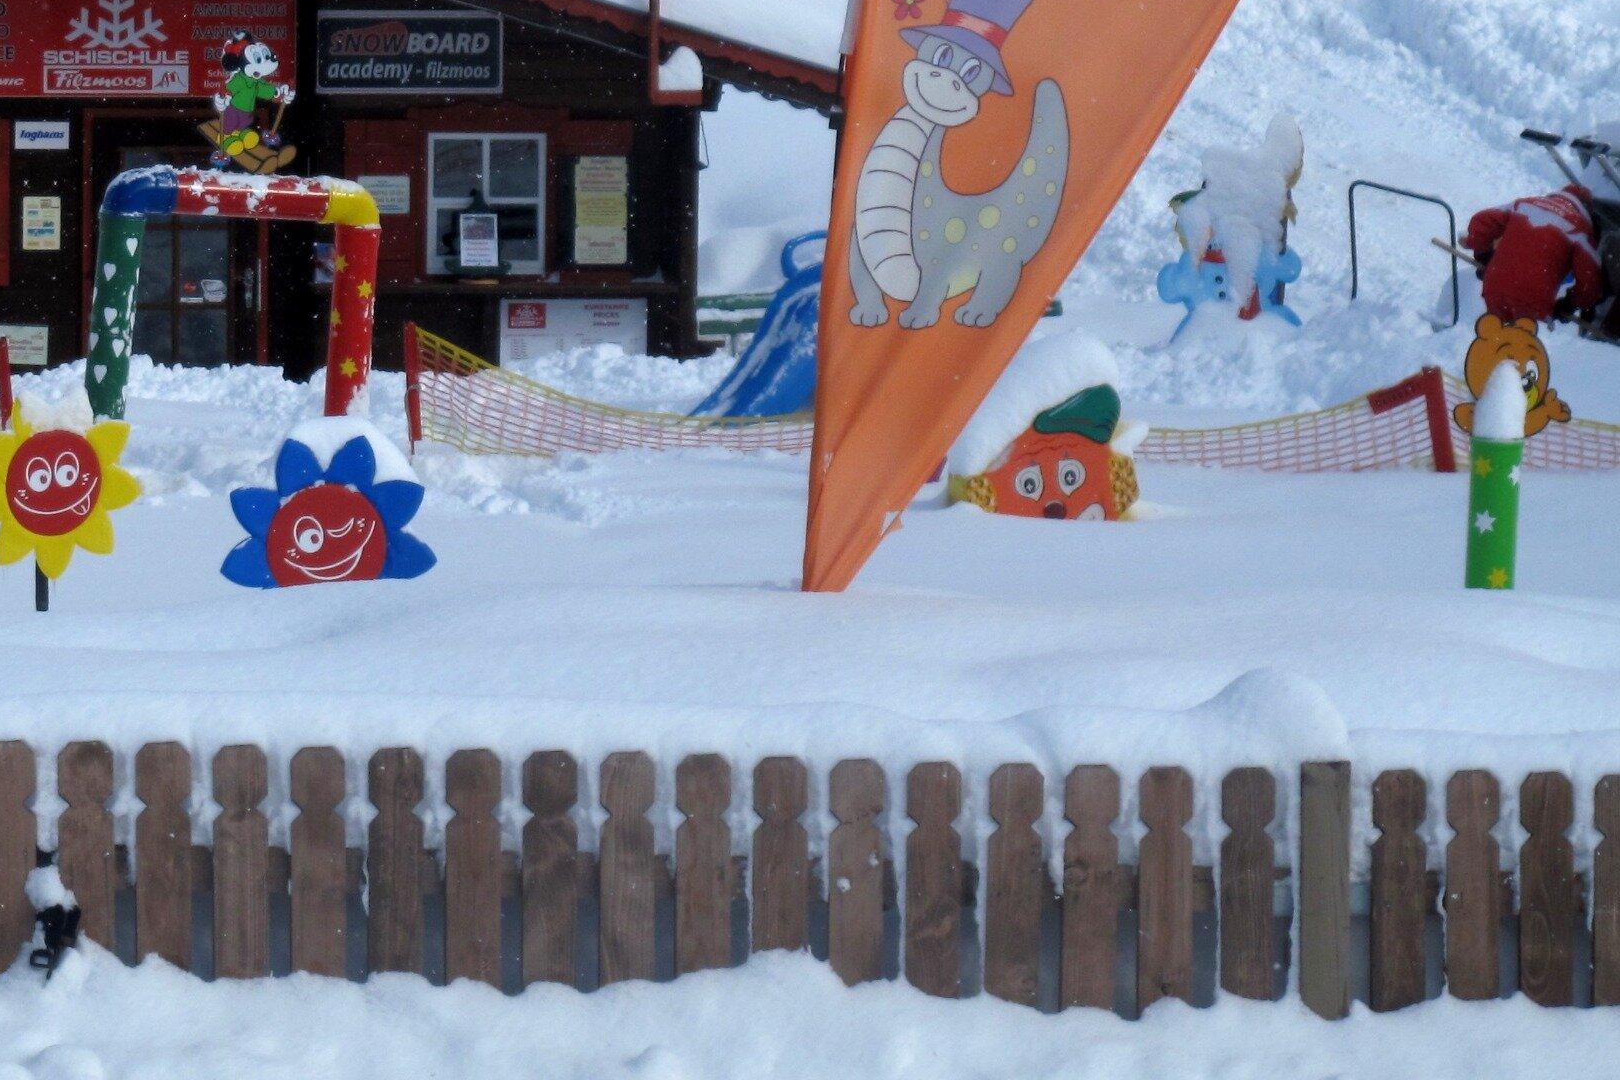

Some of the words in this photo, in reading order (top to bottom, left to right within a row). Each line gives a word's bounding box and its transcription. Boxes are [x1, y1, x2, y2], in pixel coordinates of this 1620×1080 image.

[331, 31, 491, 55] SNOWBOARD
[43, 50, 189, 65] SCHISCHULE
[52, 69, 148, 90] Filzmoos
[328, 58, 414, 83] academy
[426, 61, 492, 80] filzmoos
